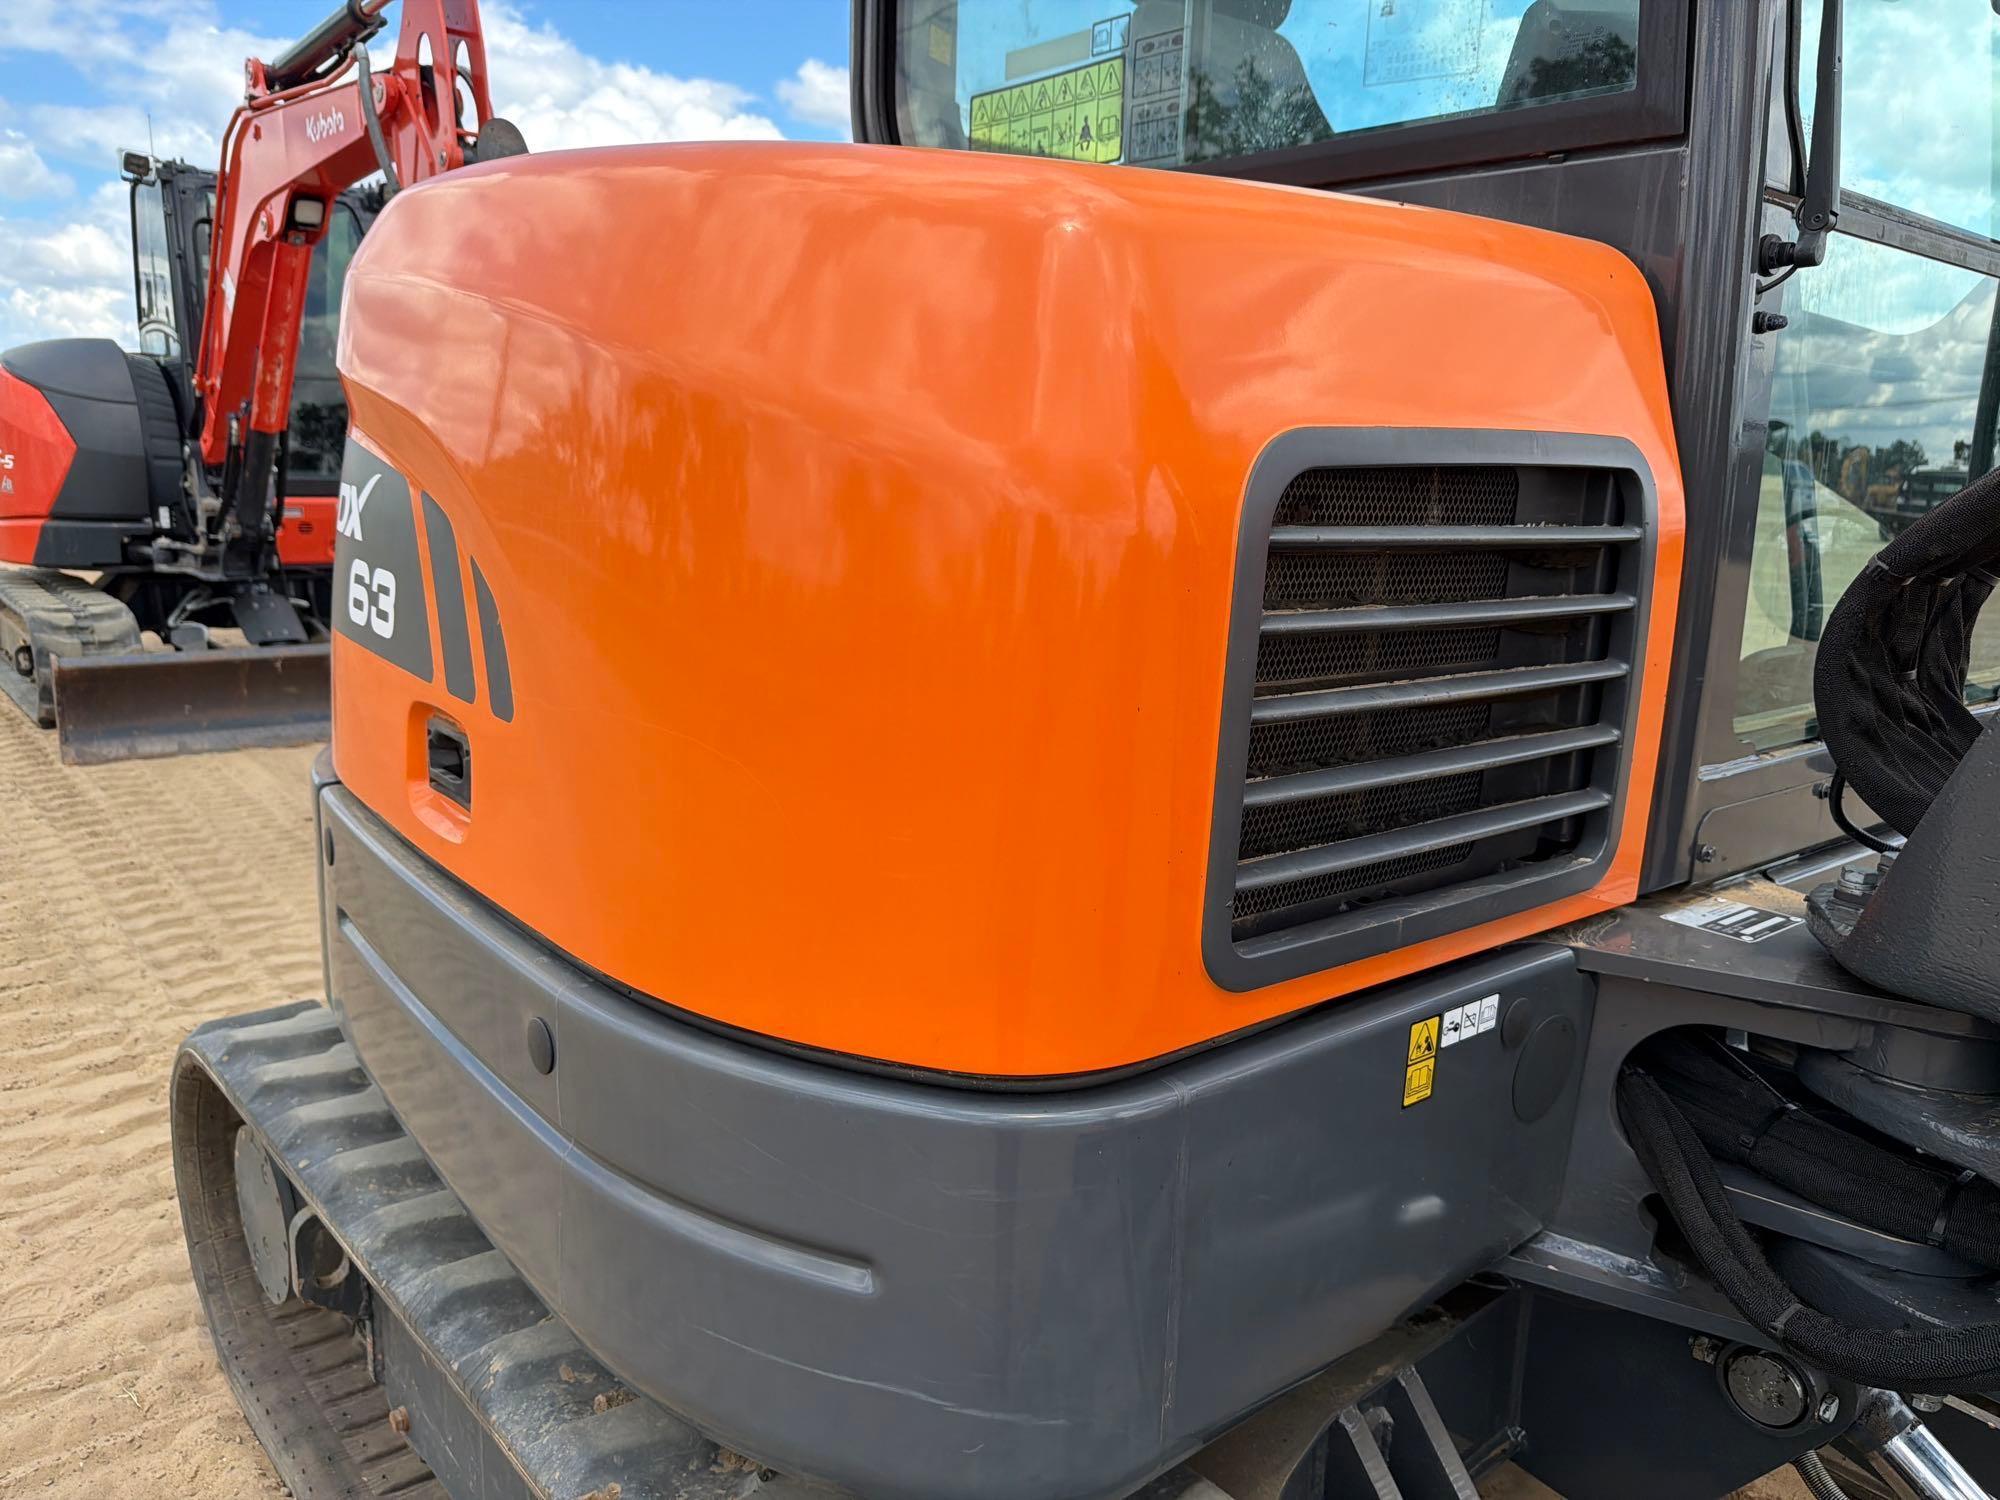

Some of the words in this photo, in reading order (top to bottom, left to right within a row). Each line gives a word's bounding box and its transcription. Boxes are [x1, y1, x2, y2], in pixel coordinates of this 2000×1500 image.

[305, 104, 344, 143] Kubota
[336, 473, 382, 541] DX
[348, 558, 396, 639] 63
